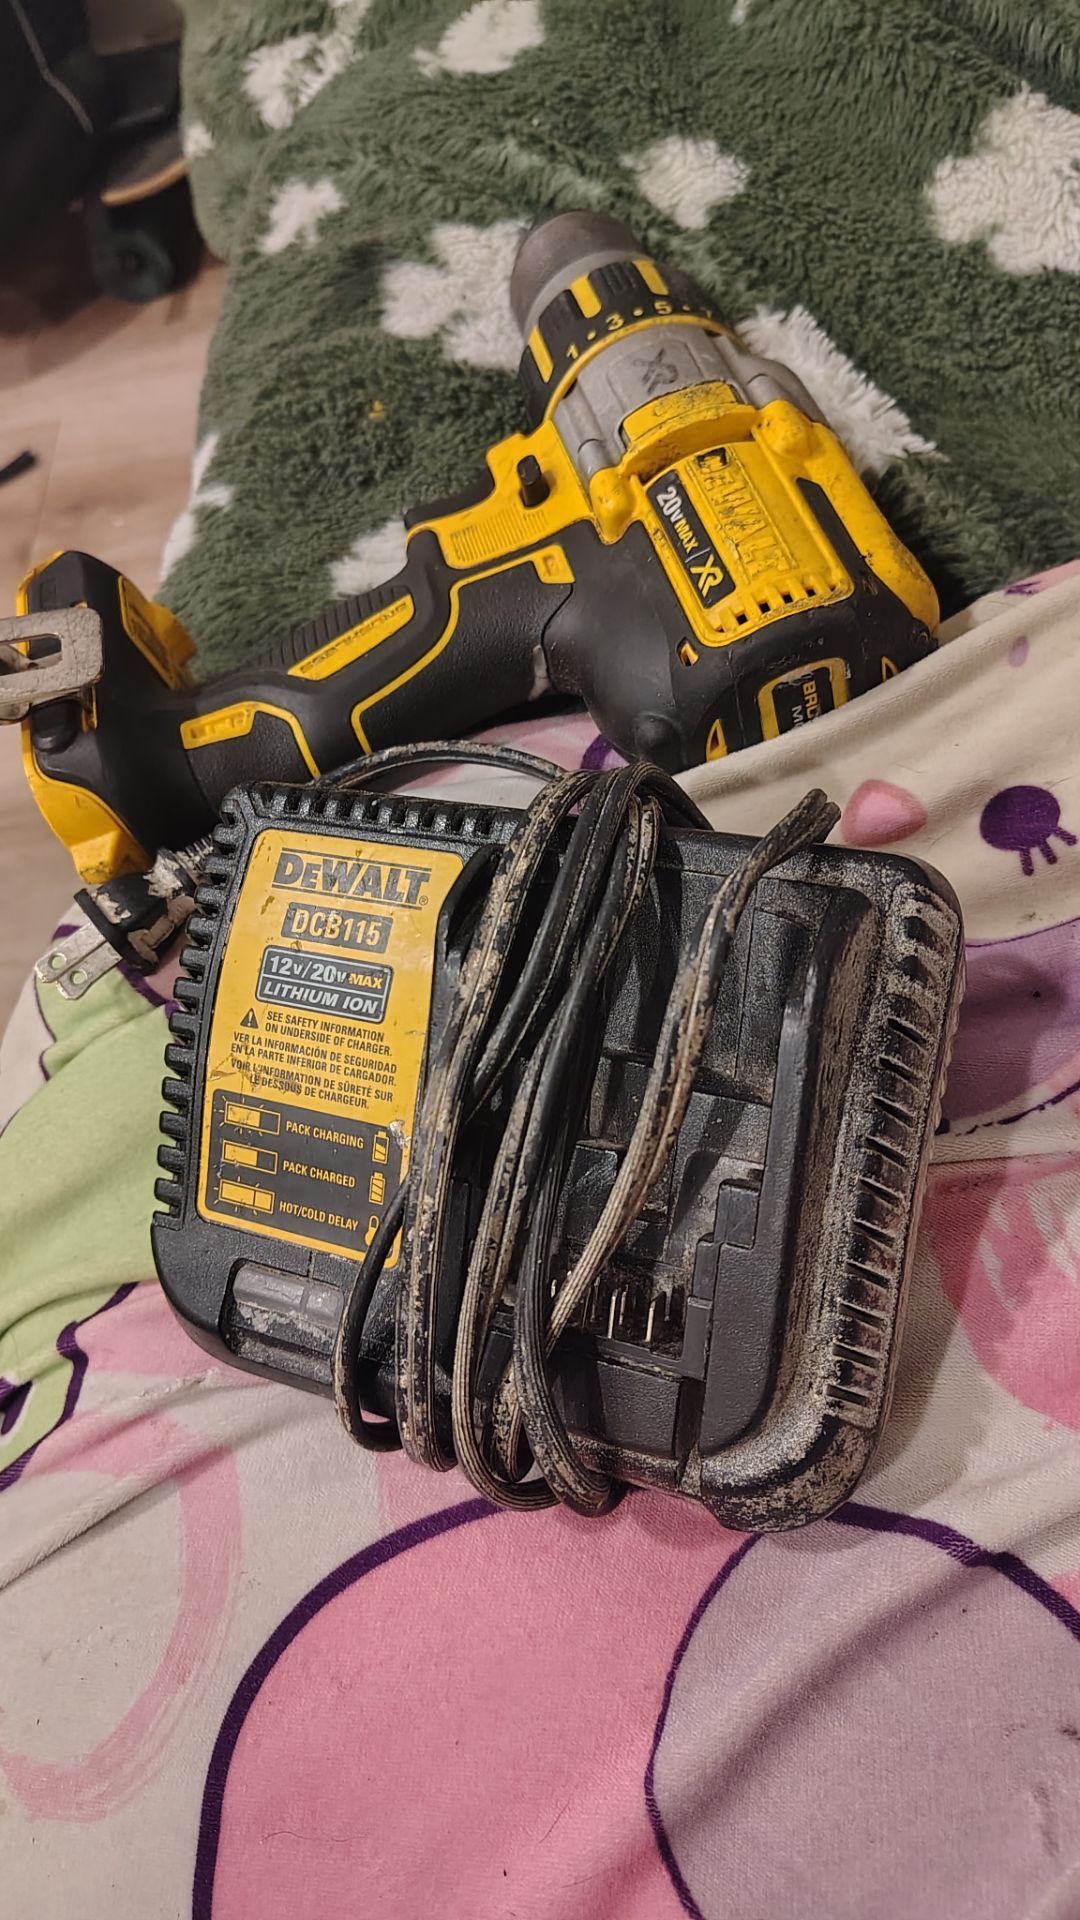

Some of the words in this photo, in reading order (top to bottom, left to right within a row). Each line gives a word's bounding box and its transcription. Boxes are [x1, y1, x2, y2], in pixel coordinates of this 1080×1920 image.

[605, 313, 624, 331] 3
[653, 301, 673, 315] 5
[690, 553, 725, 598] XR
[291, 909, 382, 946] DCB115
[263, 981, 339, 1007] LITHIUM
[342, 996, 378, 1014] ION
[265, 1022, 278, 1033] ON
[280, 1025, 331, 1044] UNDERSIDE
[333, 1036, 345, 1047] OF
[347, 1039, 393, 1057] CHARGER.
[266, 1010, 284, 1023] SEE
[285, 1014, 319, 1029] SAFETY
[320, 1021, 385, 1042] INFORMATION
[231, 1043, 244, 1053] EN
[244, 1045, 256, 1057] LA
[257, 1048, 285, 1063] PARTE
[286, 1053, 327, 1071] INFERIOR
[329, 1063, 341, 1075] DE
[343, 1066, 397, 1086] CARGADOR.
[233, 1031, 250, 1044] VER
[251, 1035, 263, 1046] LA
[264, 1038, 327, 1060] INFORMACIÓN
[329, 1051, 341, 1062] DE
[344, 1054, 397, 1074] SEGURIDAD
[231, 1058, 251, 1072] VOIR
[323, 1078, 335, 1089] DE
[338, 1081, 372, 1098] SÛRETÉ
[374, 1090, 394, 1102] SUR
[250, 1074, 260, 1085] LE
[261, 1076, 302, 1095] DESSOUS
[304, 1086, 316, 1098] DE
[318, 1089, 369, 1109] CHARGEUR.
[286, 1120, 311, 1136] PACK
[313, 1127, 365, 1149] CHARGING
[283, 1160, 308, 1176] PACK
[309, 1167, 356, 1188] CHARGED
[279, 1200, 326, 1223] HOT/COLD
[328, 1213, 359, 1231] DELAY
